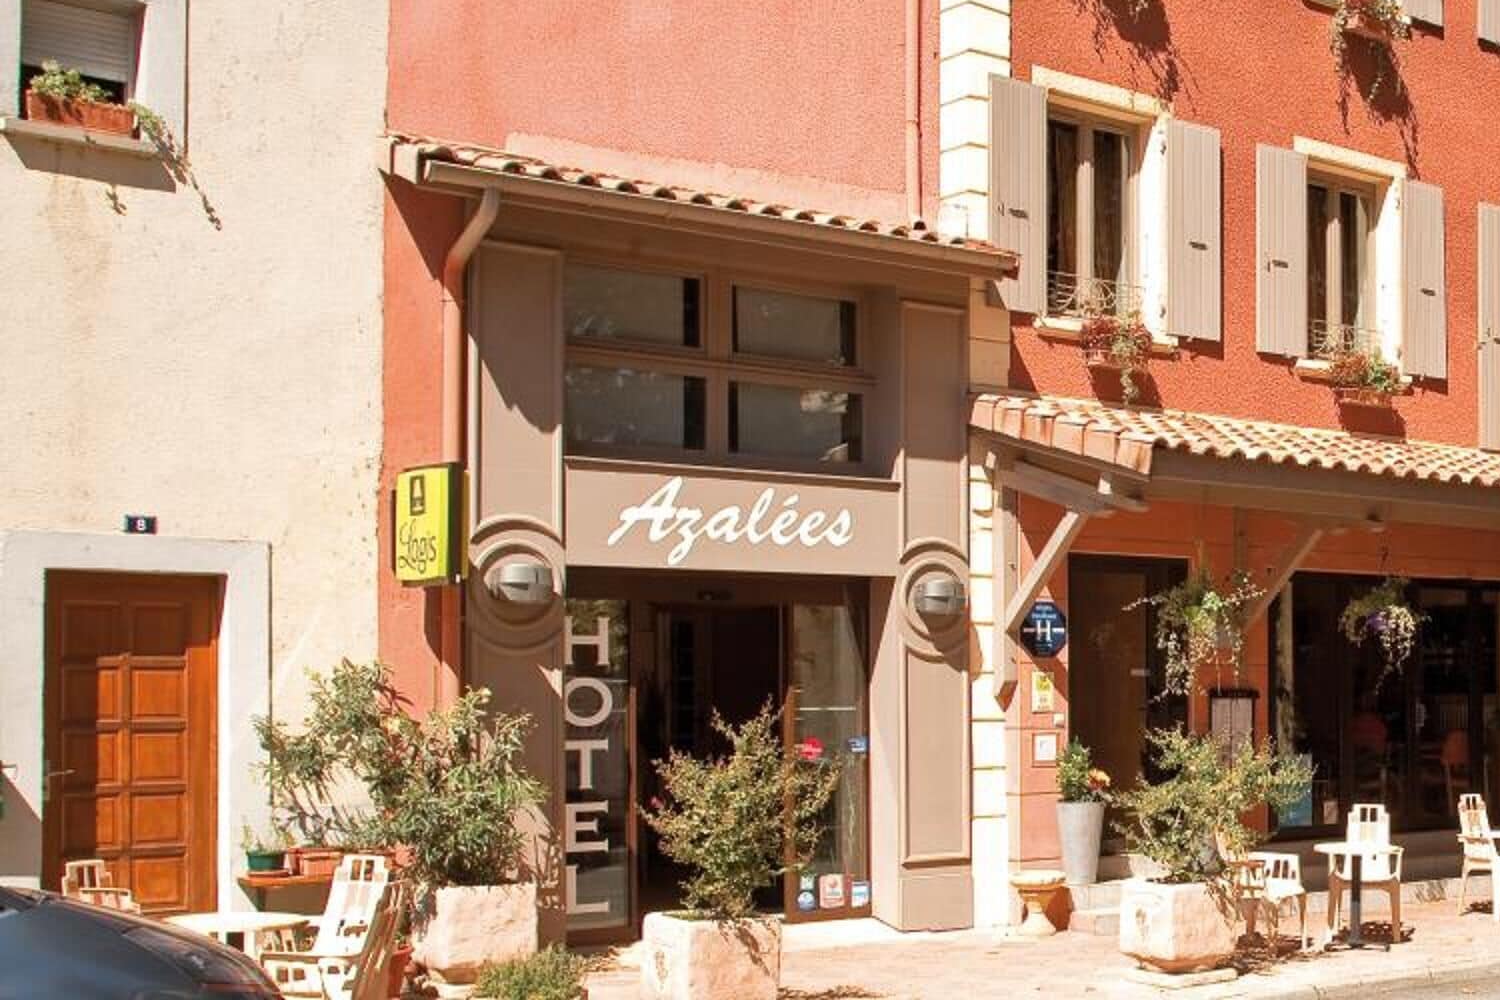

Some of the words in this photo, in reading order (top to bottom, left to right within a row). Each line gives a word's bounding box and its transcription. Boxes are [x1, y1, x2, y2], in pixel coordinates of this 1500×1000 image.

[399, 518, 437, 574] Logis
[608, 476, 854, 565] Azalées
[1036, 619, 1051, 642] H
[564, 615, 613, 914] HOTEL
